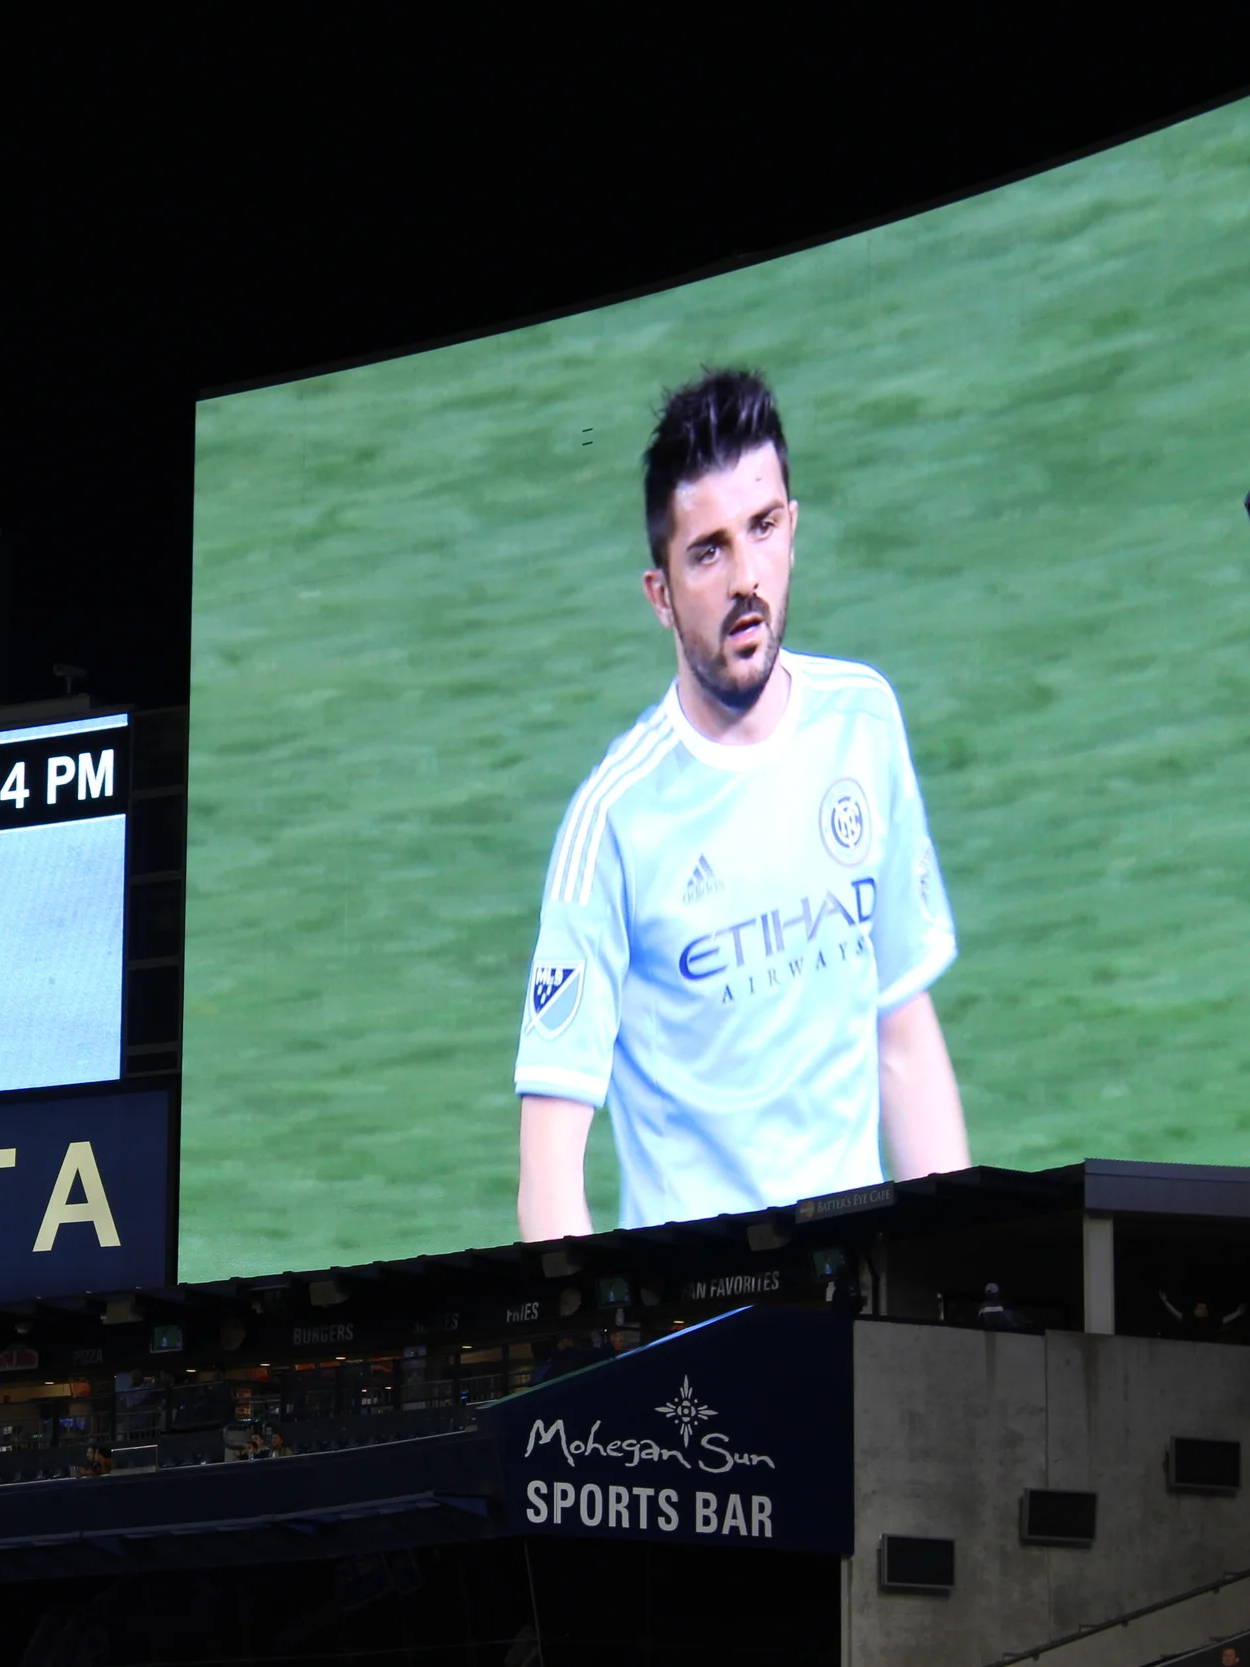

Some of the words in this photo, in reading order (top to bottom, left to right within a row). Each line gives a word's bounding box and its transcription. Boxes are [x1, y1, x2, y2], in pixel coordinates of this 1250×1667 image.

[47, 748, 114, 805] PM
[677, 876, 878, 983] ETIHAD
[720, 935, 870, 1006] AIRWAYS
[710, 1270, 781, 1298] FAVORITES
[293, 1321, 355, 1346] BURGERS
[524, 1419, 692, 1469] Mohegan
[698, 1432, 776, 1474] Sun
[526, 1479, 680, 1533] SPORTS
[695, 1490, 773, 1538] BAR
